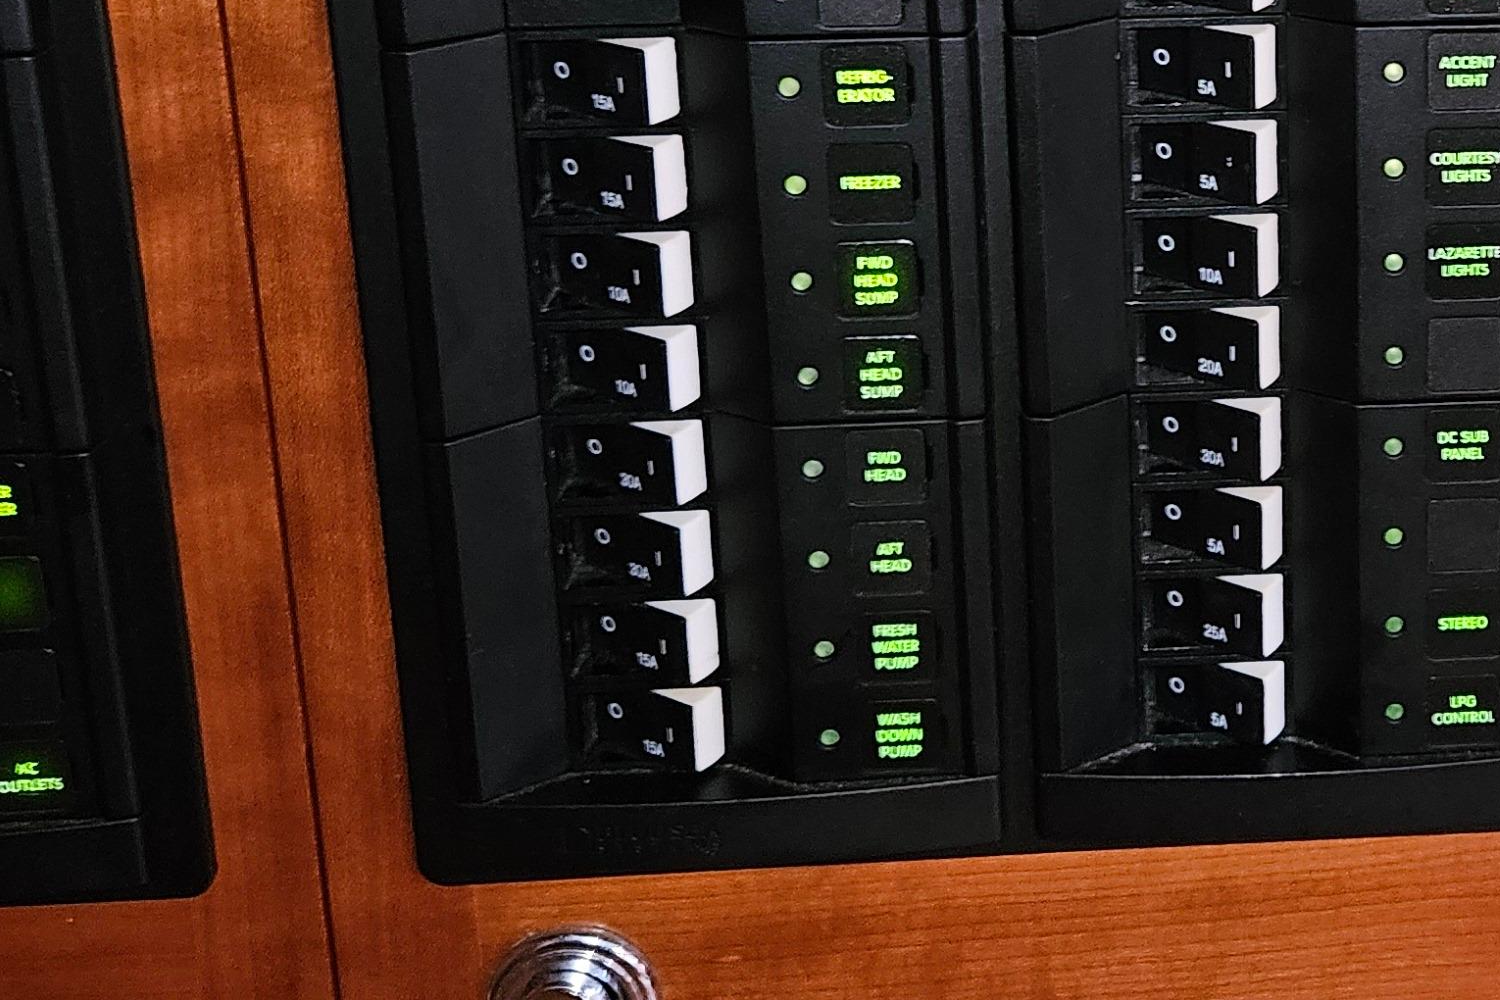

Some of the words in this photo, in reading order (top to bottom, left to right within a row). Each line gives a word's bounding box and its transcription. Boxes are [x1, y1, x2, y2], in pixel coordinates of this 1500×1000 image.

[1439, 55, 1496, 69] ACCENT
[1447, 74, 1488, 87] LIGHT
[1198, 80, 1216, 96] 5A
[1200, 175, 1218, 190] 5A
[1442, 169, 1491, 182] LIGHTS
[1199, 268, 1222, 284] 10A
[1441, 264, 1489, 276] LIGHTS
[854, 273, 898, 287] HEAD
[855, 291, 898, 305] SUMP
[866, 351, 895, 363] AFT
[1198, 358, 1223, 376] 20A
[860, 368, 902, 381] HEAD
[860, 385, 903, 399] SUMP
[1437, 431, 1458, 444] DC
[1460, 430, 1489, 443] SUB
[1441, 447, 1484, 460] PANEL
[865, 468, 906, 481] HEAD
[1207, 538, 1224, 554] 5A
[870, 559, 912, 572] HEAD
[1438, 616, 1488, 630] STEREO
[873, 624, 917, 637] FRESH
[872, 639, 919, 653] WATER
[875, 656, 918, 669] PUMP
[1449, 695, 1476, 708] LPG
[877, 712, 920, 726] WASH
[1432, 711, 1495, 725] CONTROL
[876, 728, 923, 743] DOWN
[643, 740, 664, 757] 15A
[879, 745, 922, 758] PUMP
